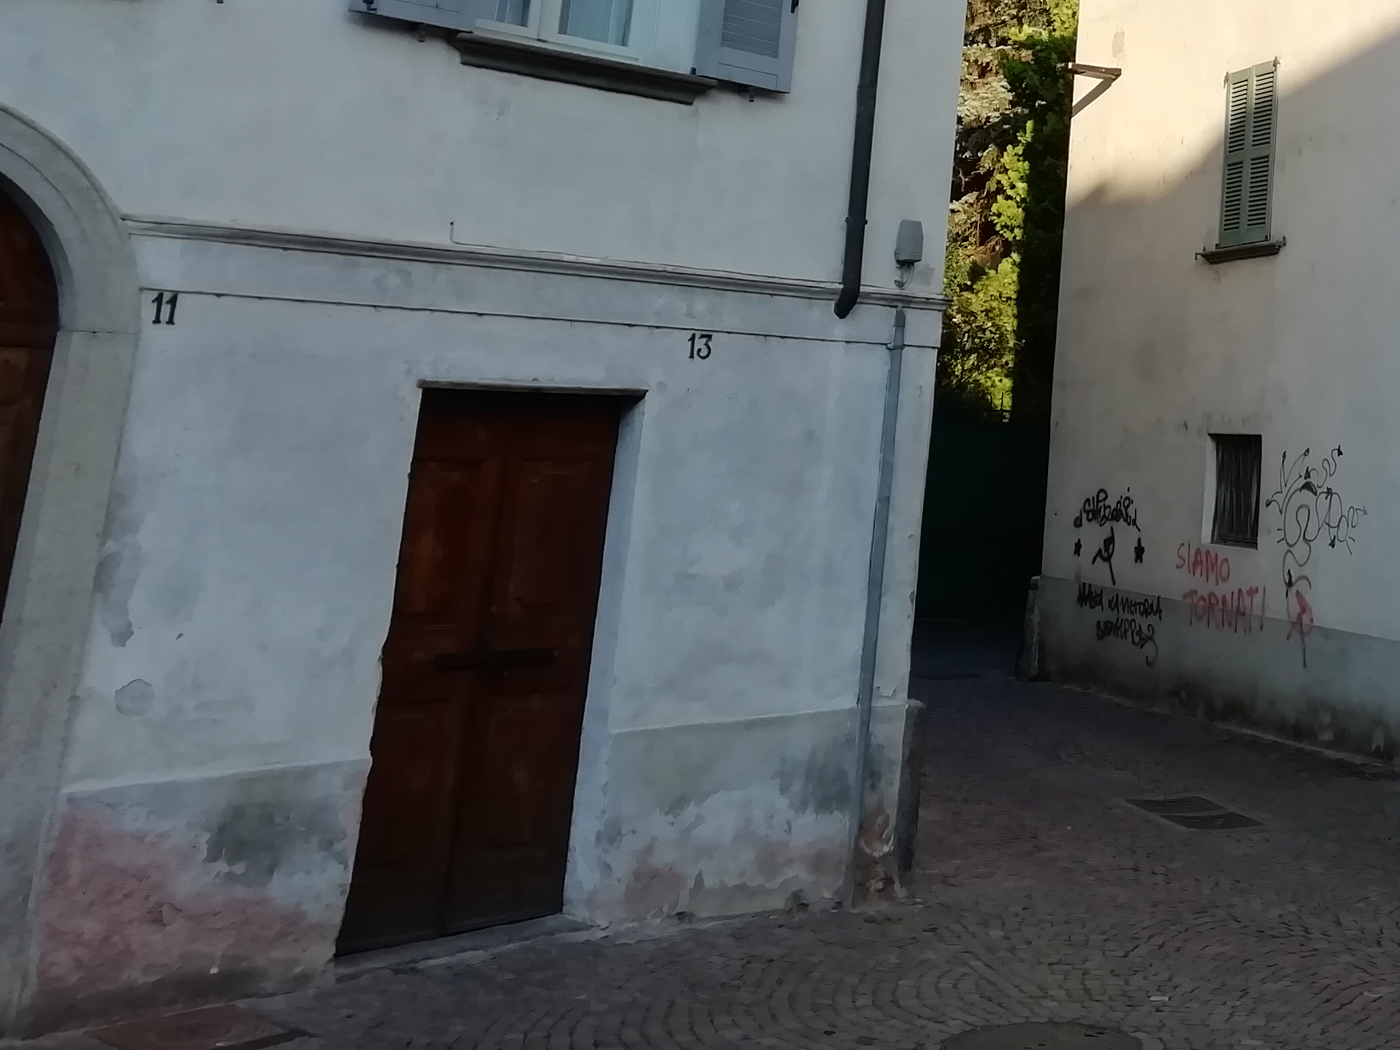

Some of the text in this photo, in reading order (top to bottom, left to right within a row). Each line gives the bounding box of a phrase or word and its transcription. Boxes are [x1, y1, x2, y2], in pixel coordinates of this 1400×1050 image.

[151, 292, 179, 326] 11
[687, 332, 713, 360] 13
[1175, 541, 1231, 586] SIAMO
[1182, 585, 1266, 634] TORNATI
